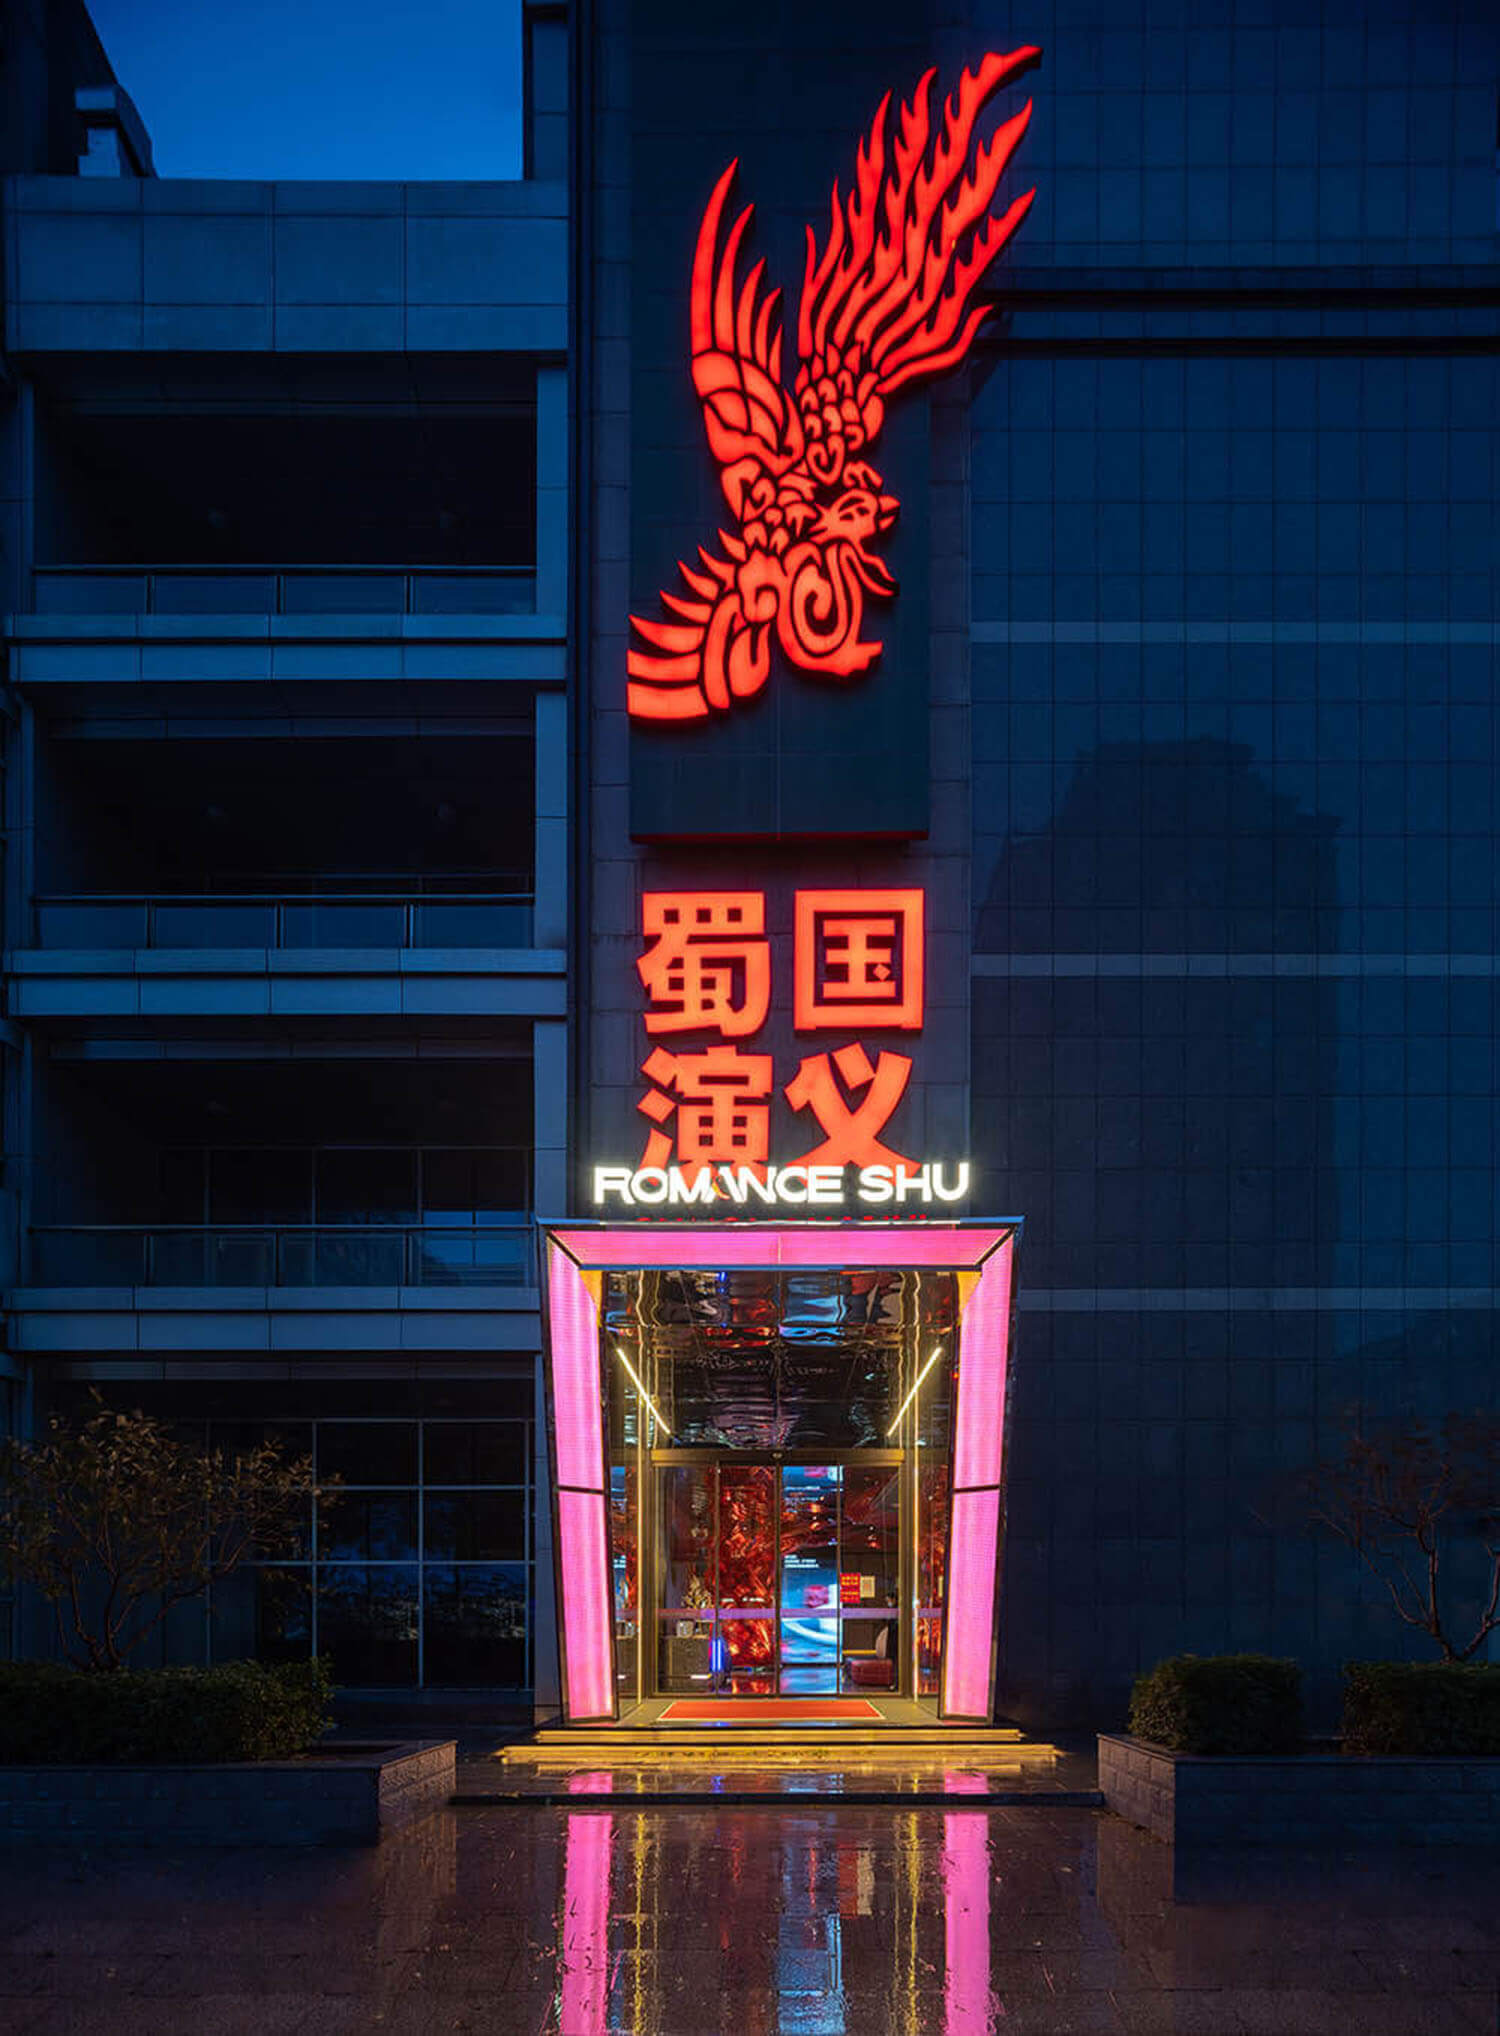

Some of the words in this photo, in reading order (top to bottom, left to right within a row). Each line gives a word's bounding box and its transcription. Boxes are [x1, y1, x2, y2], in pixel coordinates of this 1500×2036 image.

[636, 888, 925, 1037] 蜀国
[594, 1166, 844, 1204] ROMANCE
[858, 1162, 970, 1202] SHU
[636, 1041, 922, 1187] 演义
